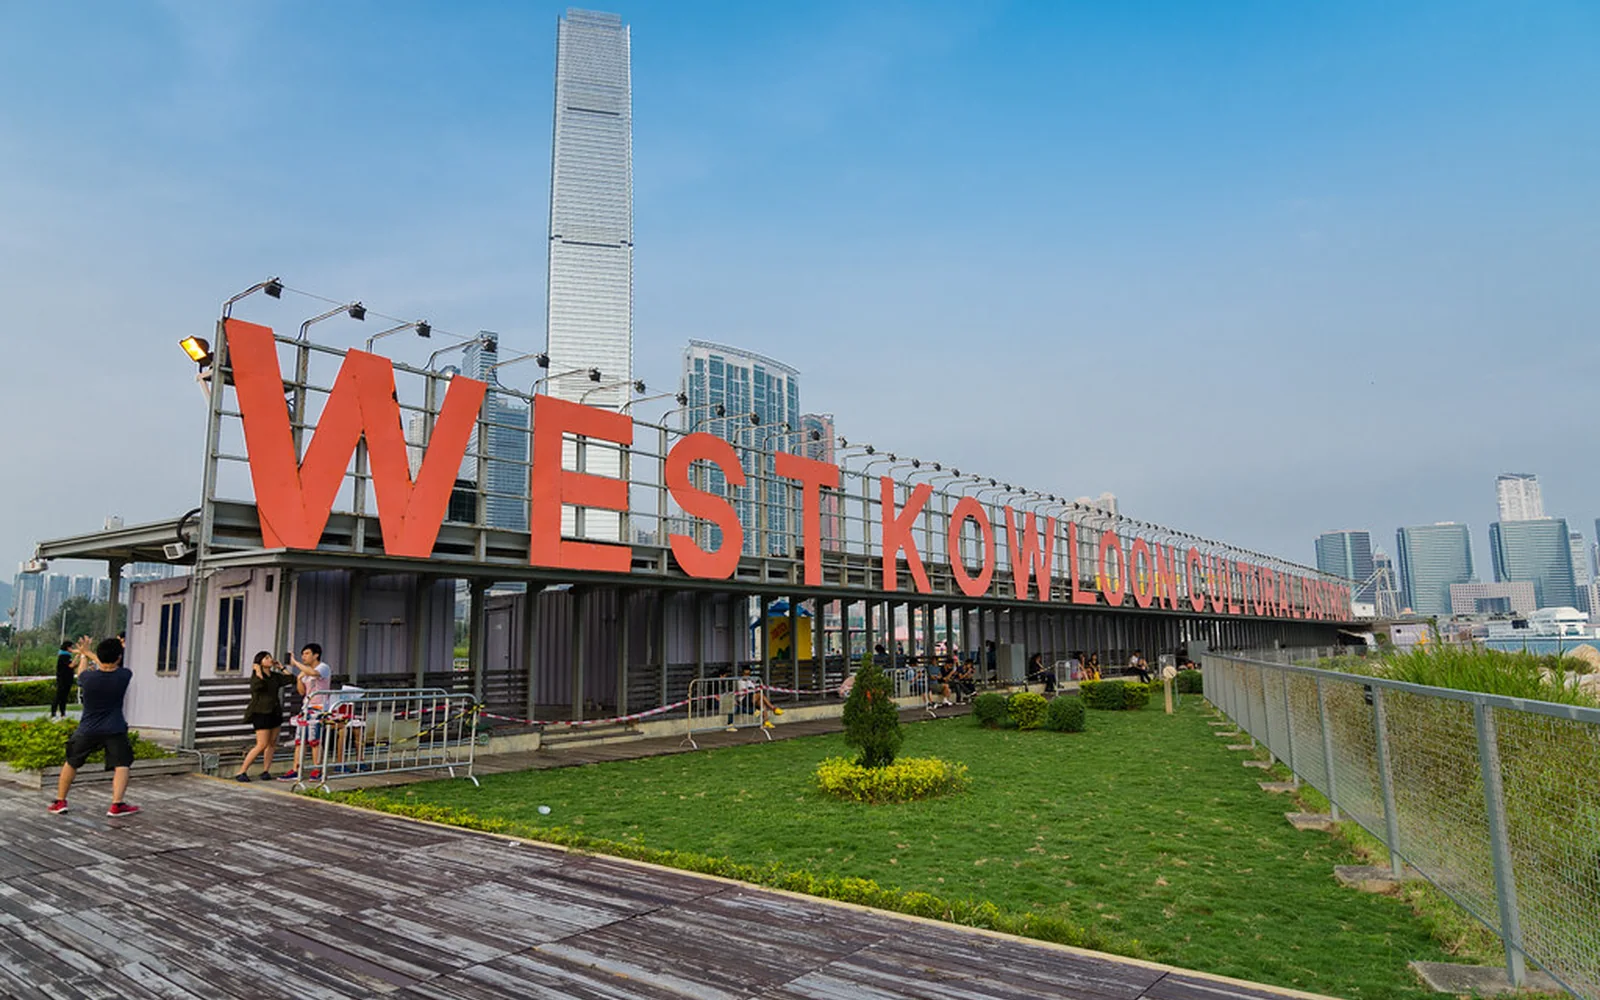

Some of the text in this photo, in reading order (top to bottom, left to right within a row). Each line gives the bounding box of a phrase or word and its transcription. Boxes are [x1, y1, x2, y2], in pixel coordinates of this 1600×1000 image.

[225, 318, 1352, 622] WEST KOWLOON CULTURAL DISTRICT
